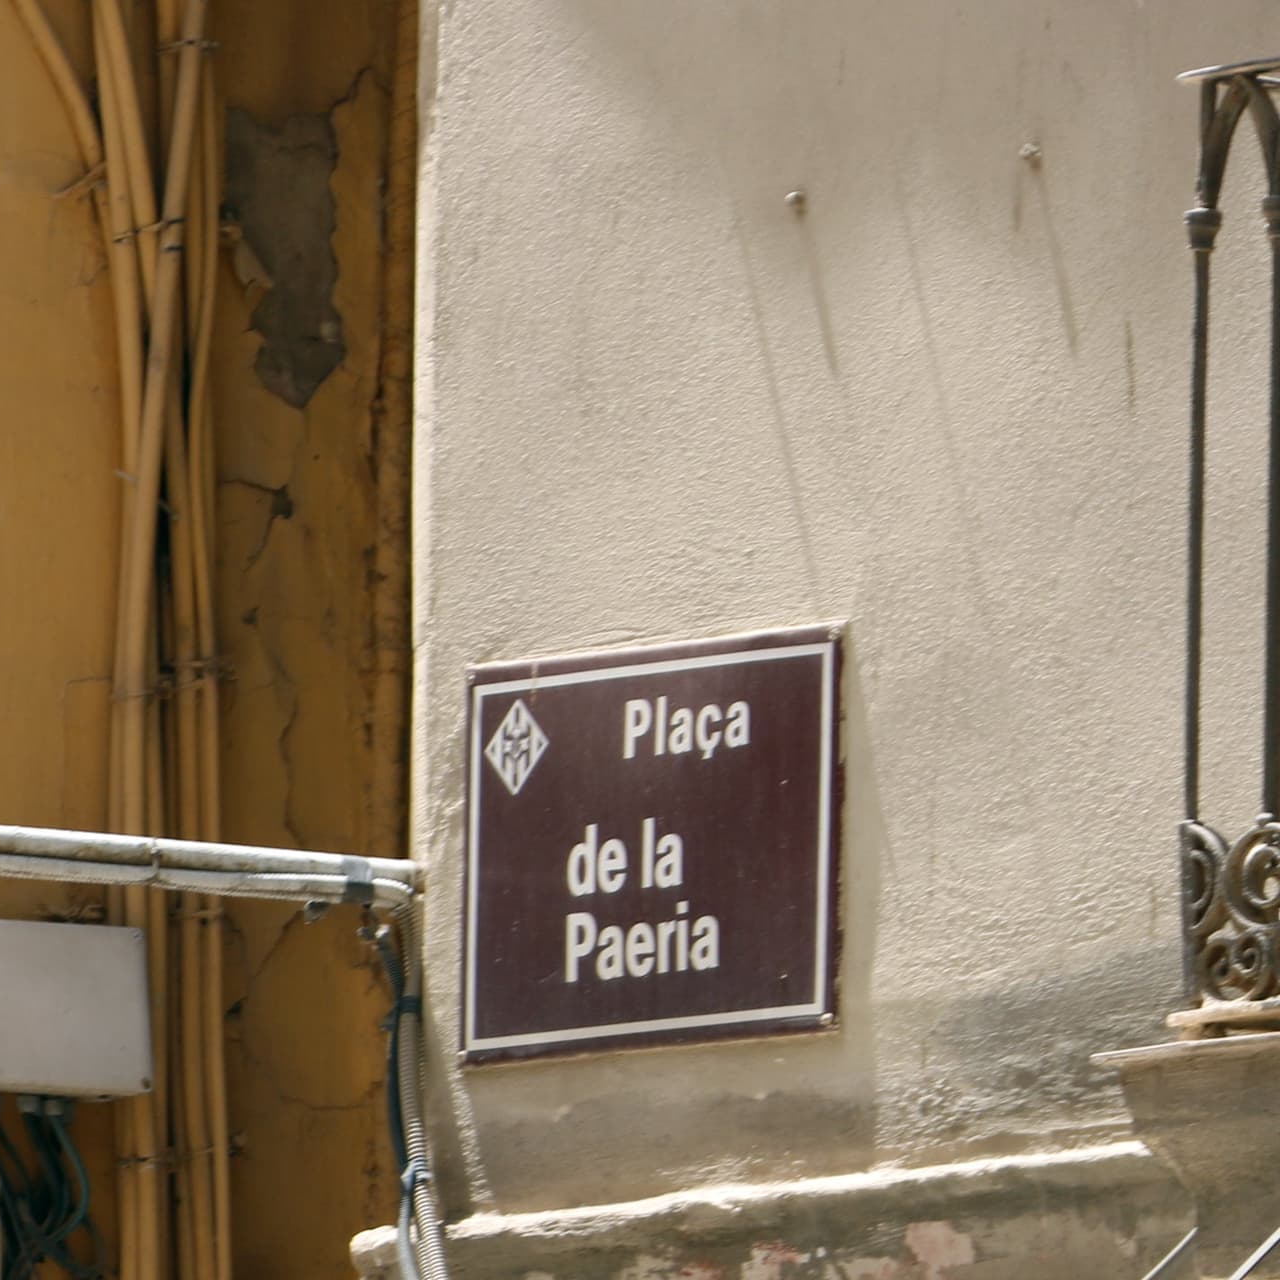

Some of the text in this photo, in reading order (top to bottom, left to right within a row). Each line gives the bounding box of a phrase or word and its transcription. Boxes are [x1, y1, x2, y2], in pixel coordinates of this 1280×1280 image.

[622, 695, 751, 760] Plaça
[566, 817, 684, 897] de la
[564, 901, 720, 984] Paeria
